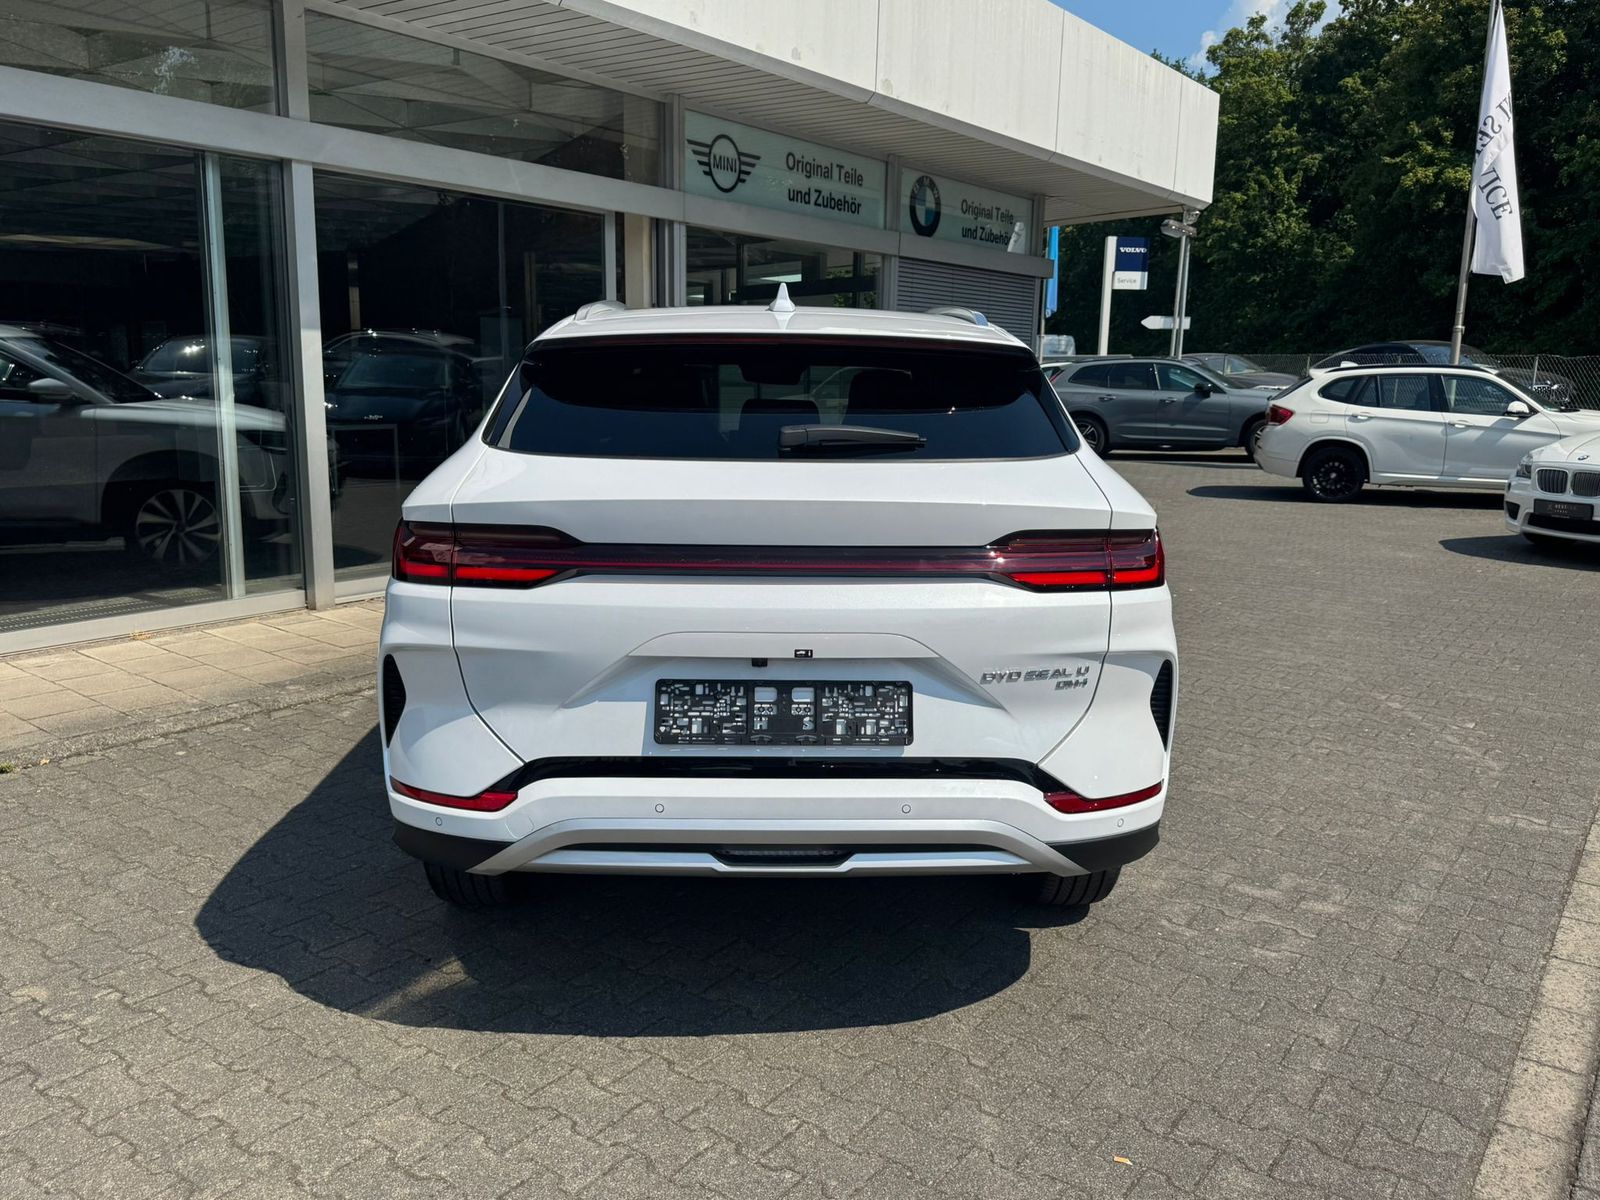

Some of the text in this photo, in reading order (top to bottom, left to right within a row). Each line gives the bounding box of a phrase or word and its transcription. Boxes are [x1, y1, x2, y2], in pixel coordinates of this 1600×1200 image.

[712, 154, 737, 173] MINI
[786, 152, 864, 187] Original Teile
[788, 188, 862, 215] und Zubehör
[961, 199, 1014, 225] Original Teile
[961, 226, 978, 240] und
[1119, 246, 1148, 254] VOLVO
[980, 671, 1022, 684] BYD
[1023, 667, 1073, 682] SEAL
